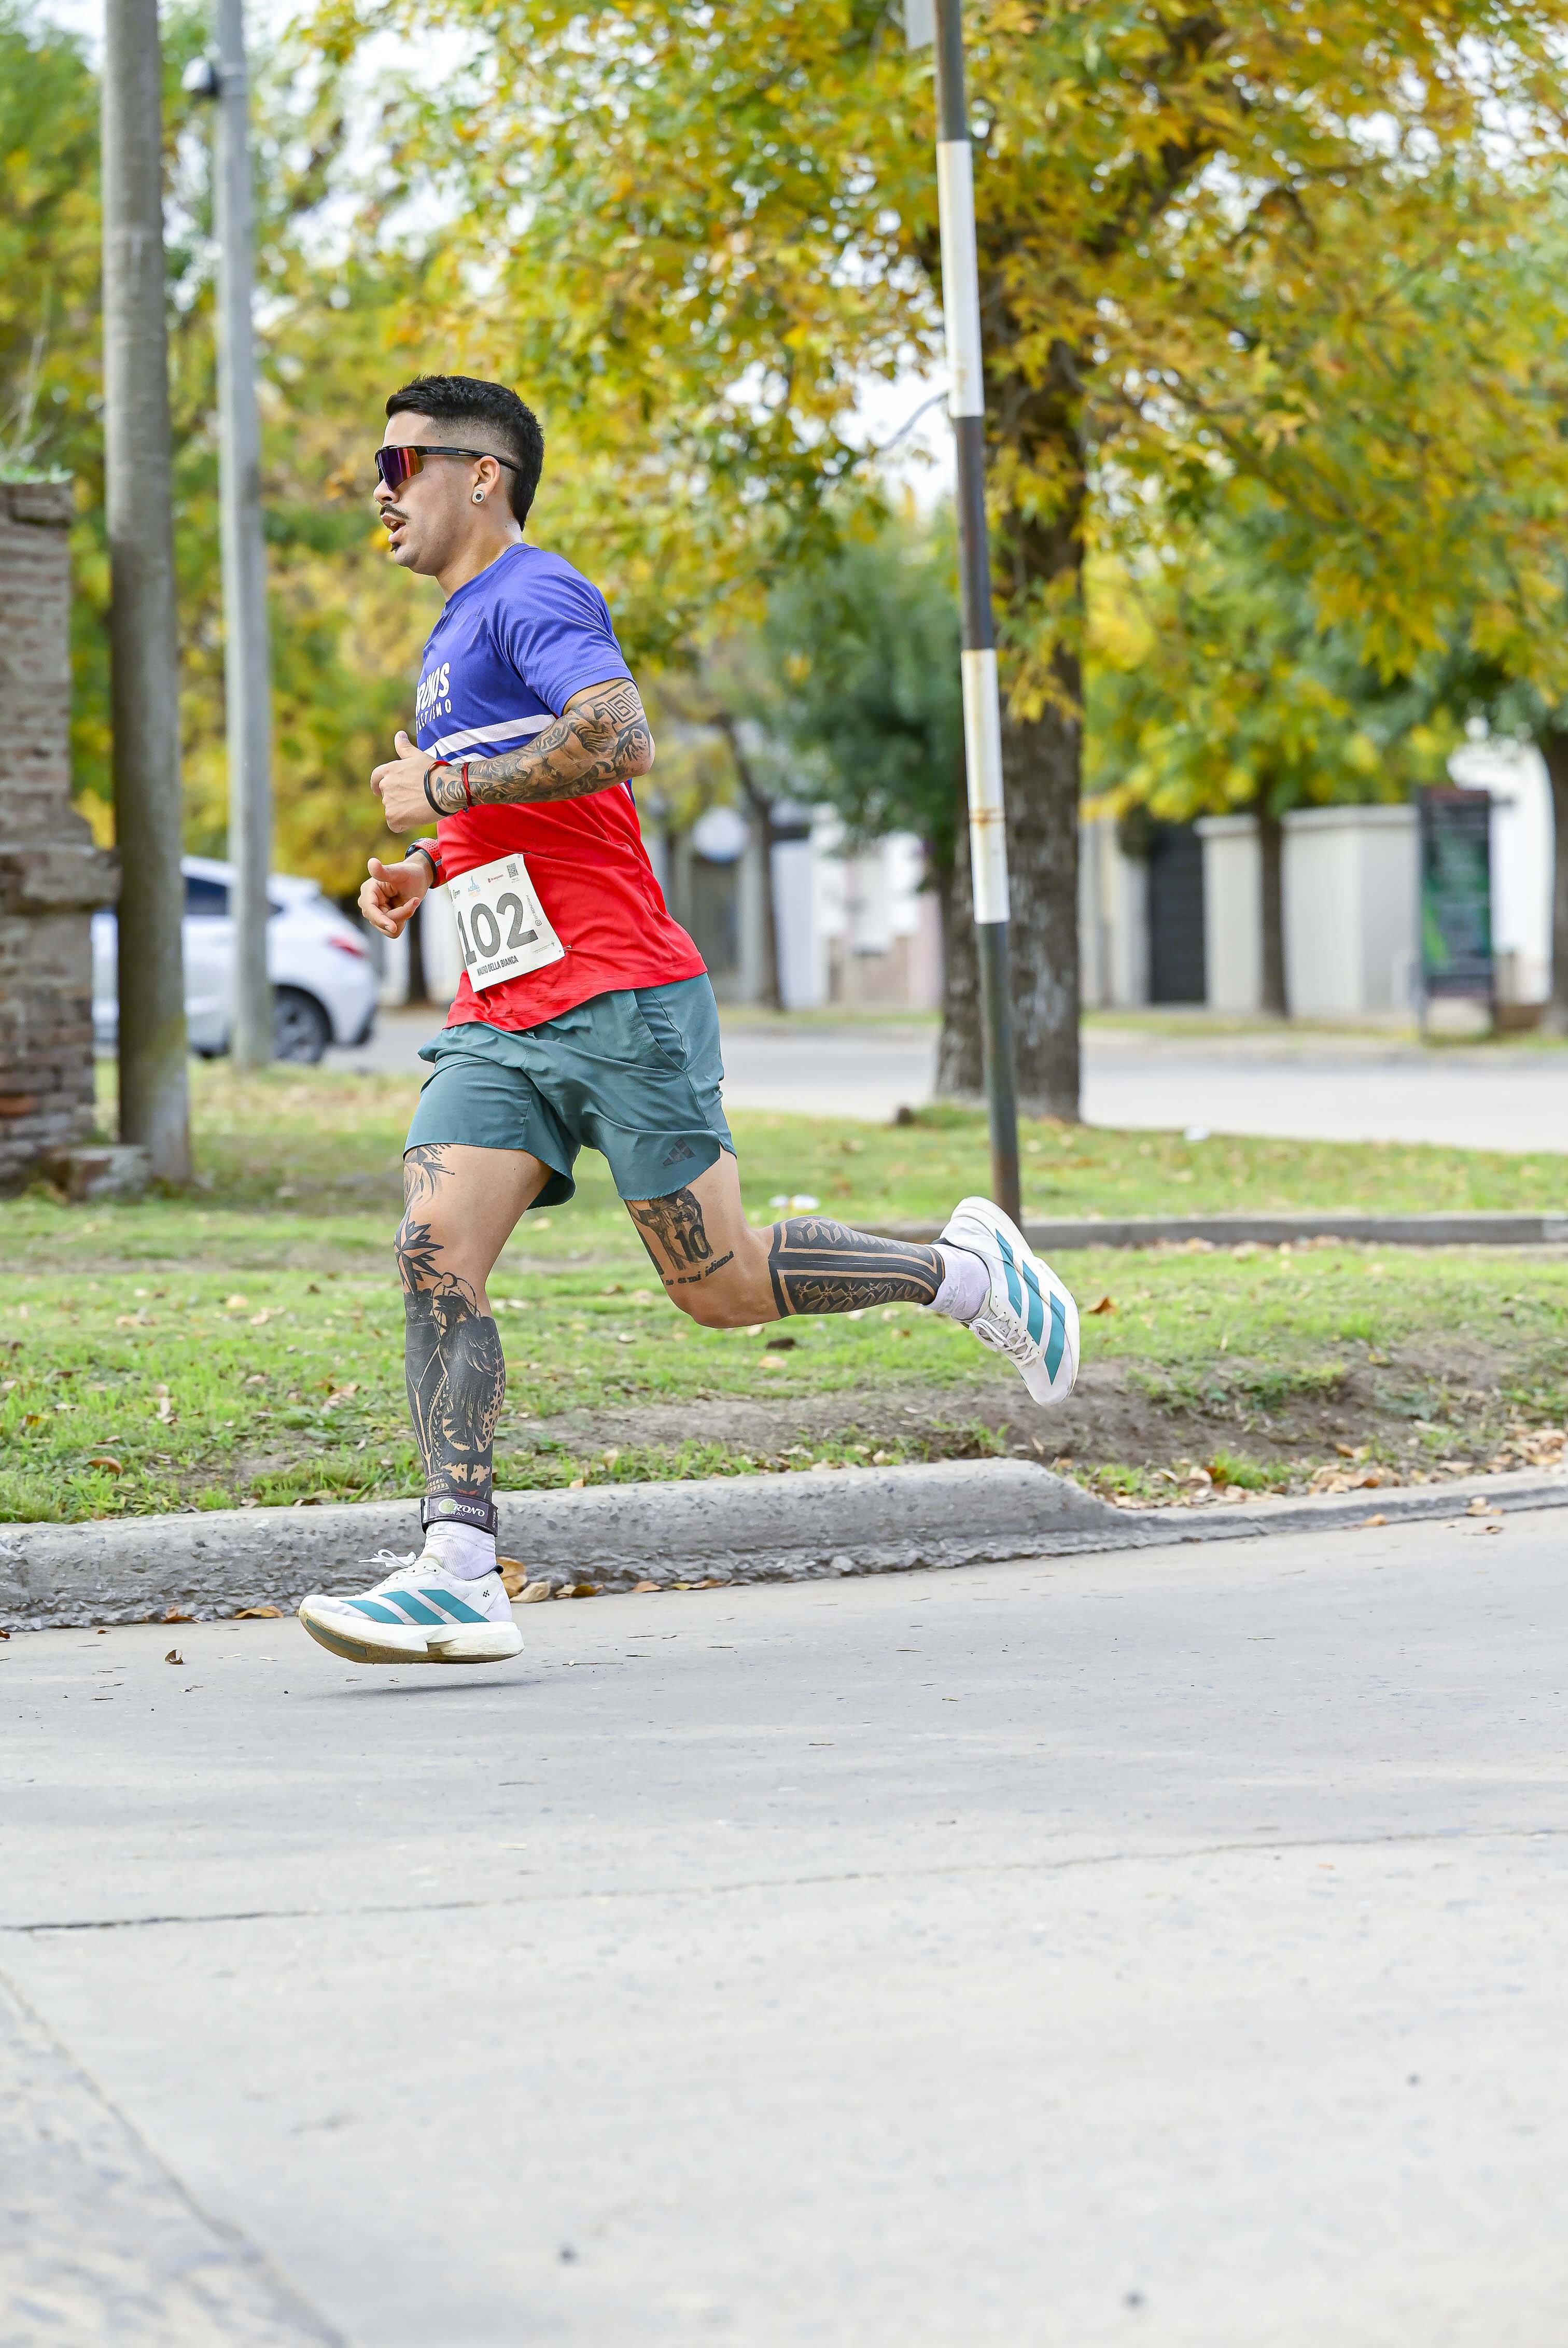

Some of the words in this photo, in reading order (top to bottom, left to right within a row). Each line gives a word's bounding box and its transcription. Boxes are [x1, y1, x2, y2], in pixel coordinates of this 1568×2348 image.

[458, 893, 538, 966] 102
[488, 961, 501, 972] DELLA
[500, 955, 519, 968] BIANCA
